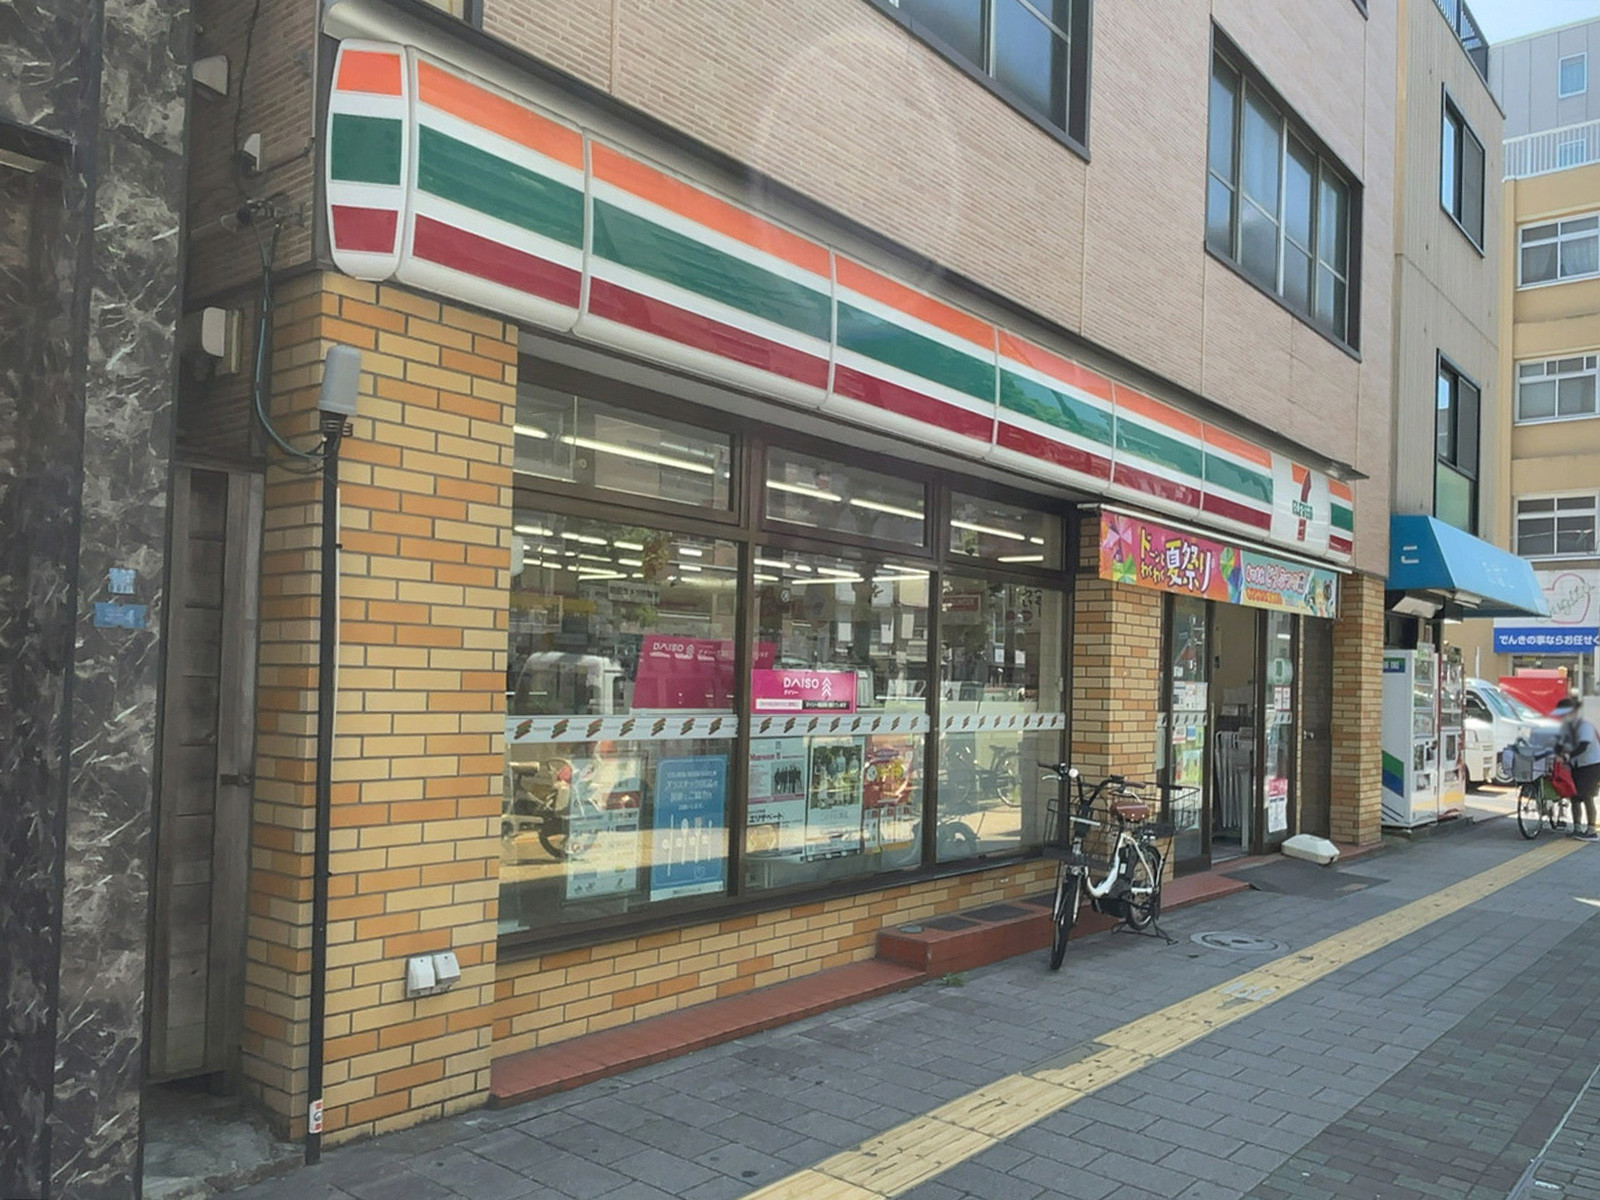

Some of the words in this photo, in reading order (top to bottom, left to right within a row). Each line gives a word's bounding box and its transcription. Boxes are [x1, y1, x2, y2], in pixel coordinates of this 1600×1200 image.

[1165, 540, 1212, 592] 夏祭り
[653, 642, 684, 653] DAISO
[783, 677, 819, 689] DAISO
